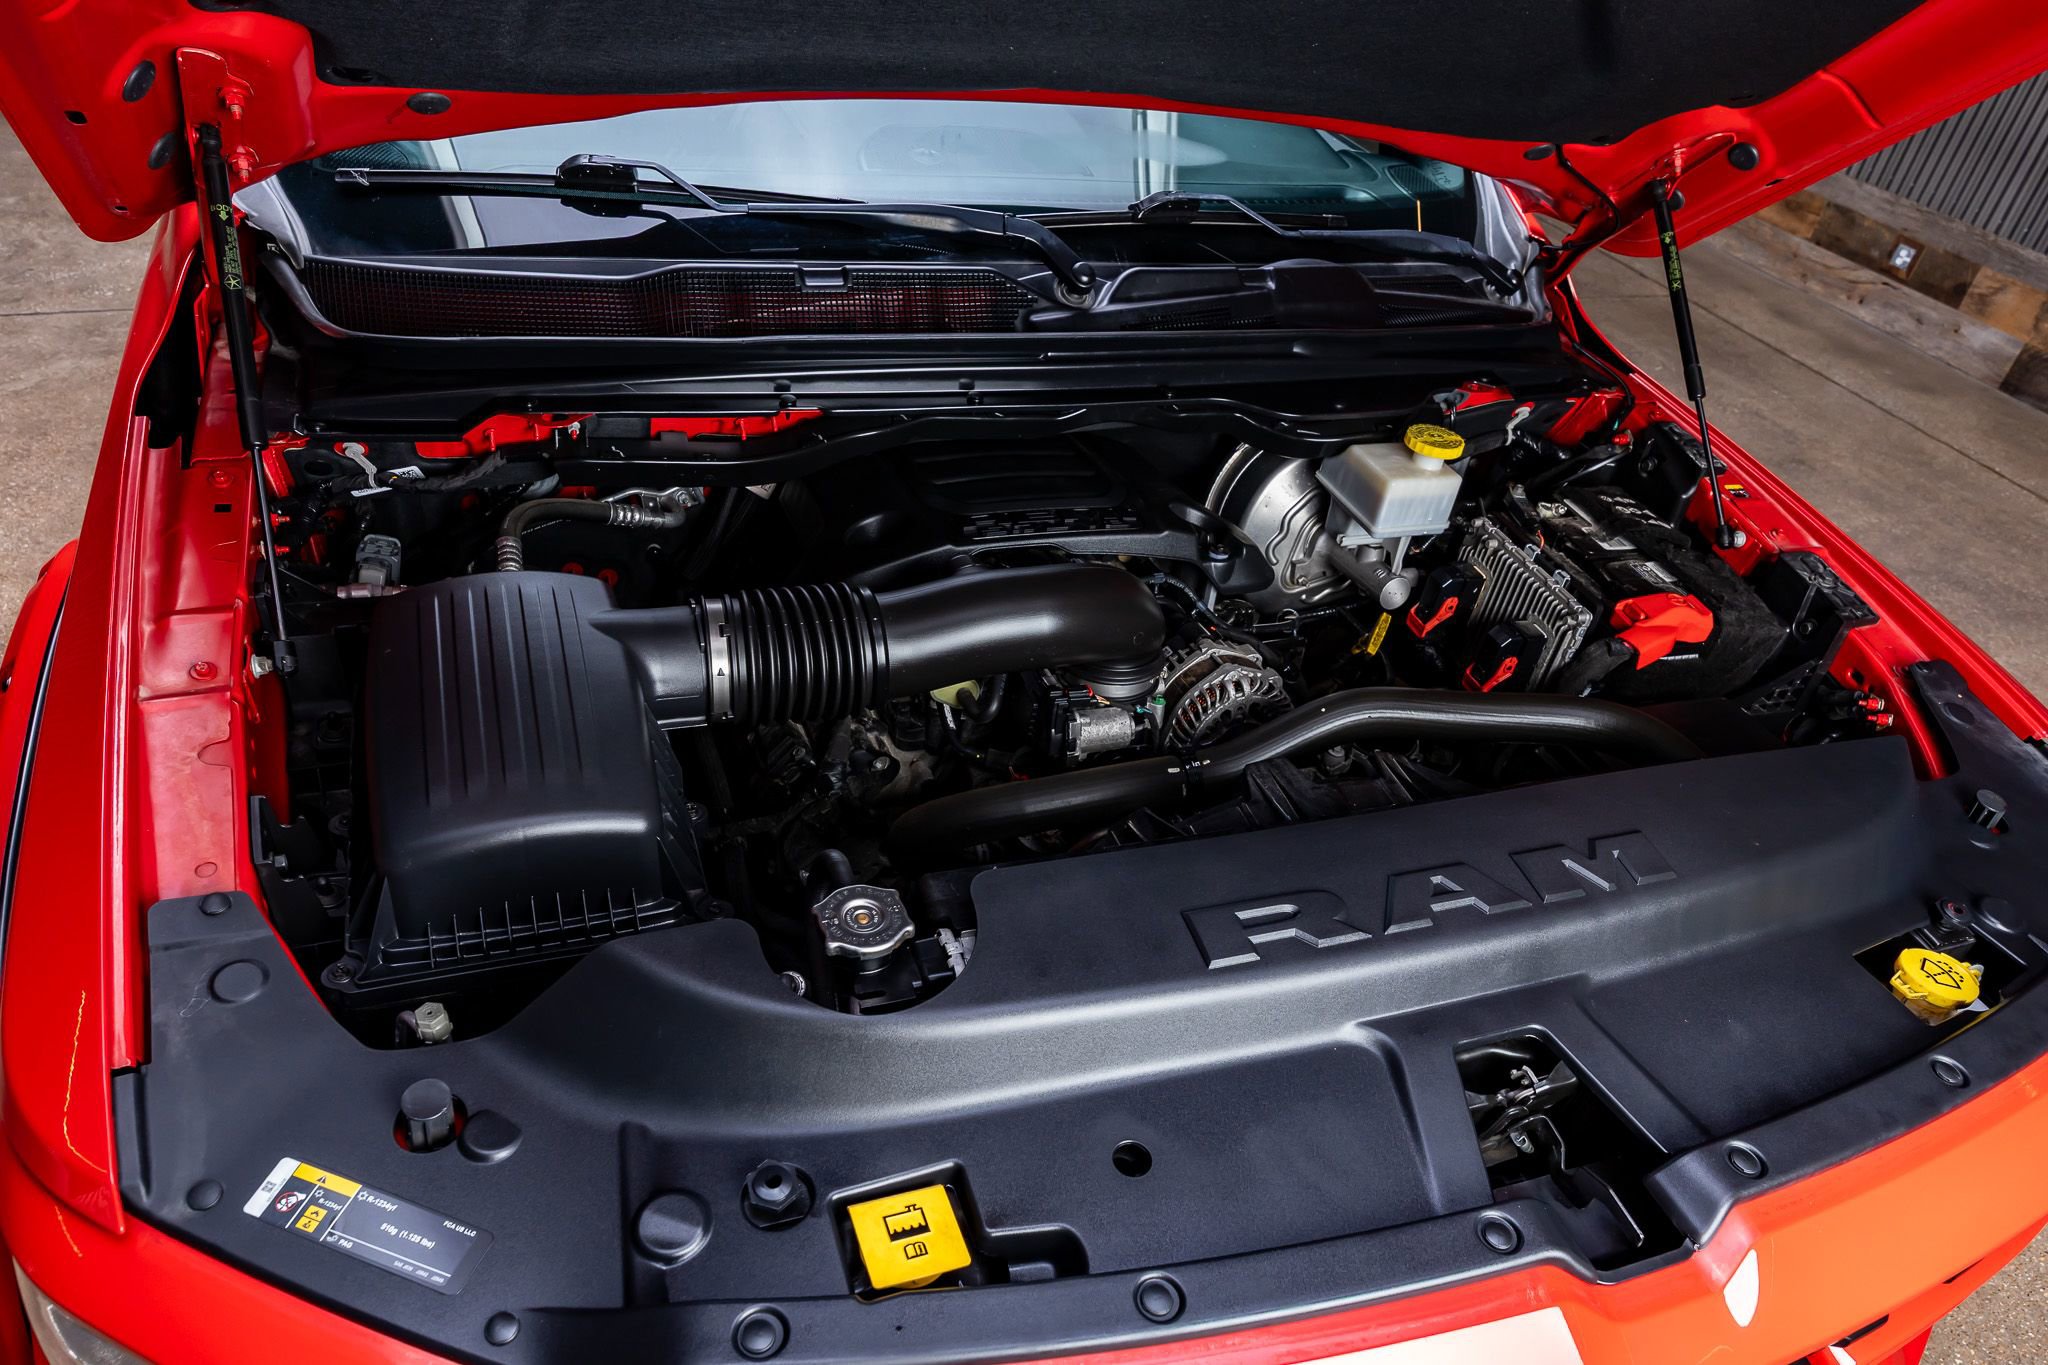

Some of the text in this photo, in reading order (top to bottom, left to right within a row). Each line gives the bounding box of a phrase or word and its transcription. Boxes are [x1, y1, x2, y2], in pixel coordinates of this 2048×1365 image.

[1180, 830, 1677, 969] RAM
[366, 1195, 398, 1212] R-1234yf
[338, 1239, 354, 1249] PAG
